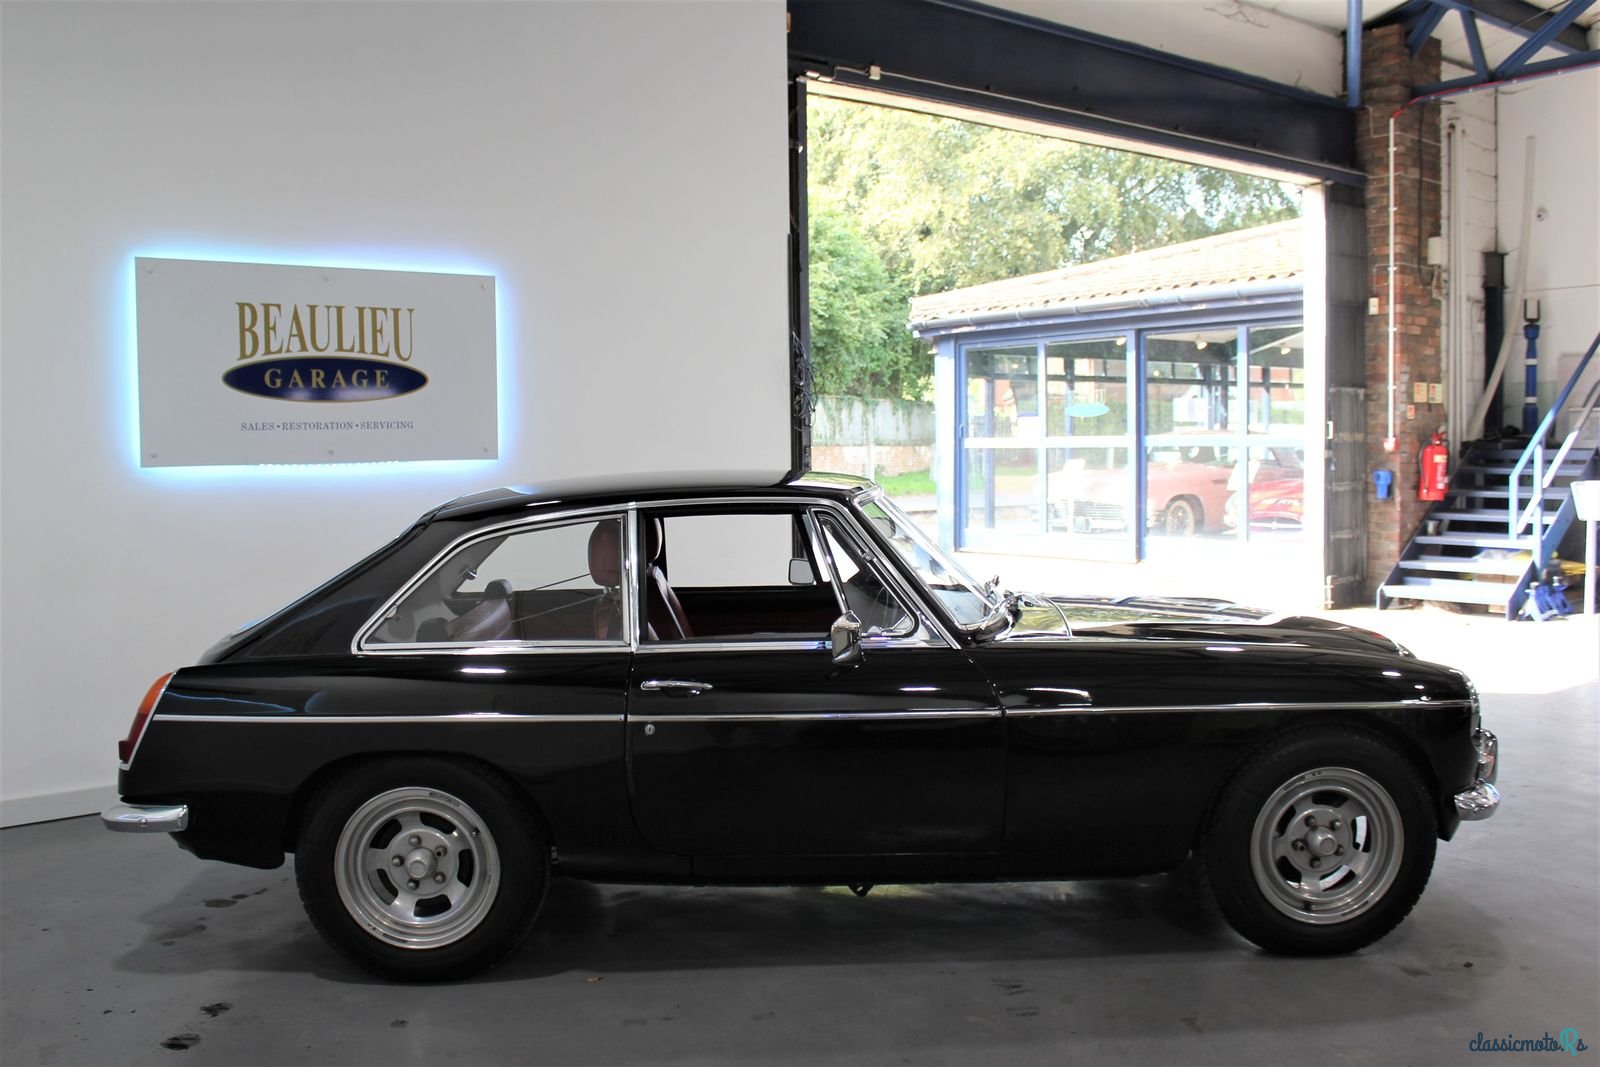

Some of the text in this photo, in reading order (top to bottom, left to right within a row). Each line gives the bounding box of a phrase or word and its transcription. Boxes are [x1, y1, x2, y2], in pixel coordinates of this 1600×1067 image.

[236, 302, 415, 361] BEAULIEU
[264, 368, 390, 389] GARAGE
[240, 421, 414, 432] SALES RESTORATION SERVICING
